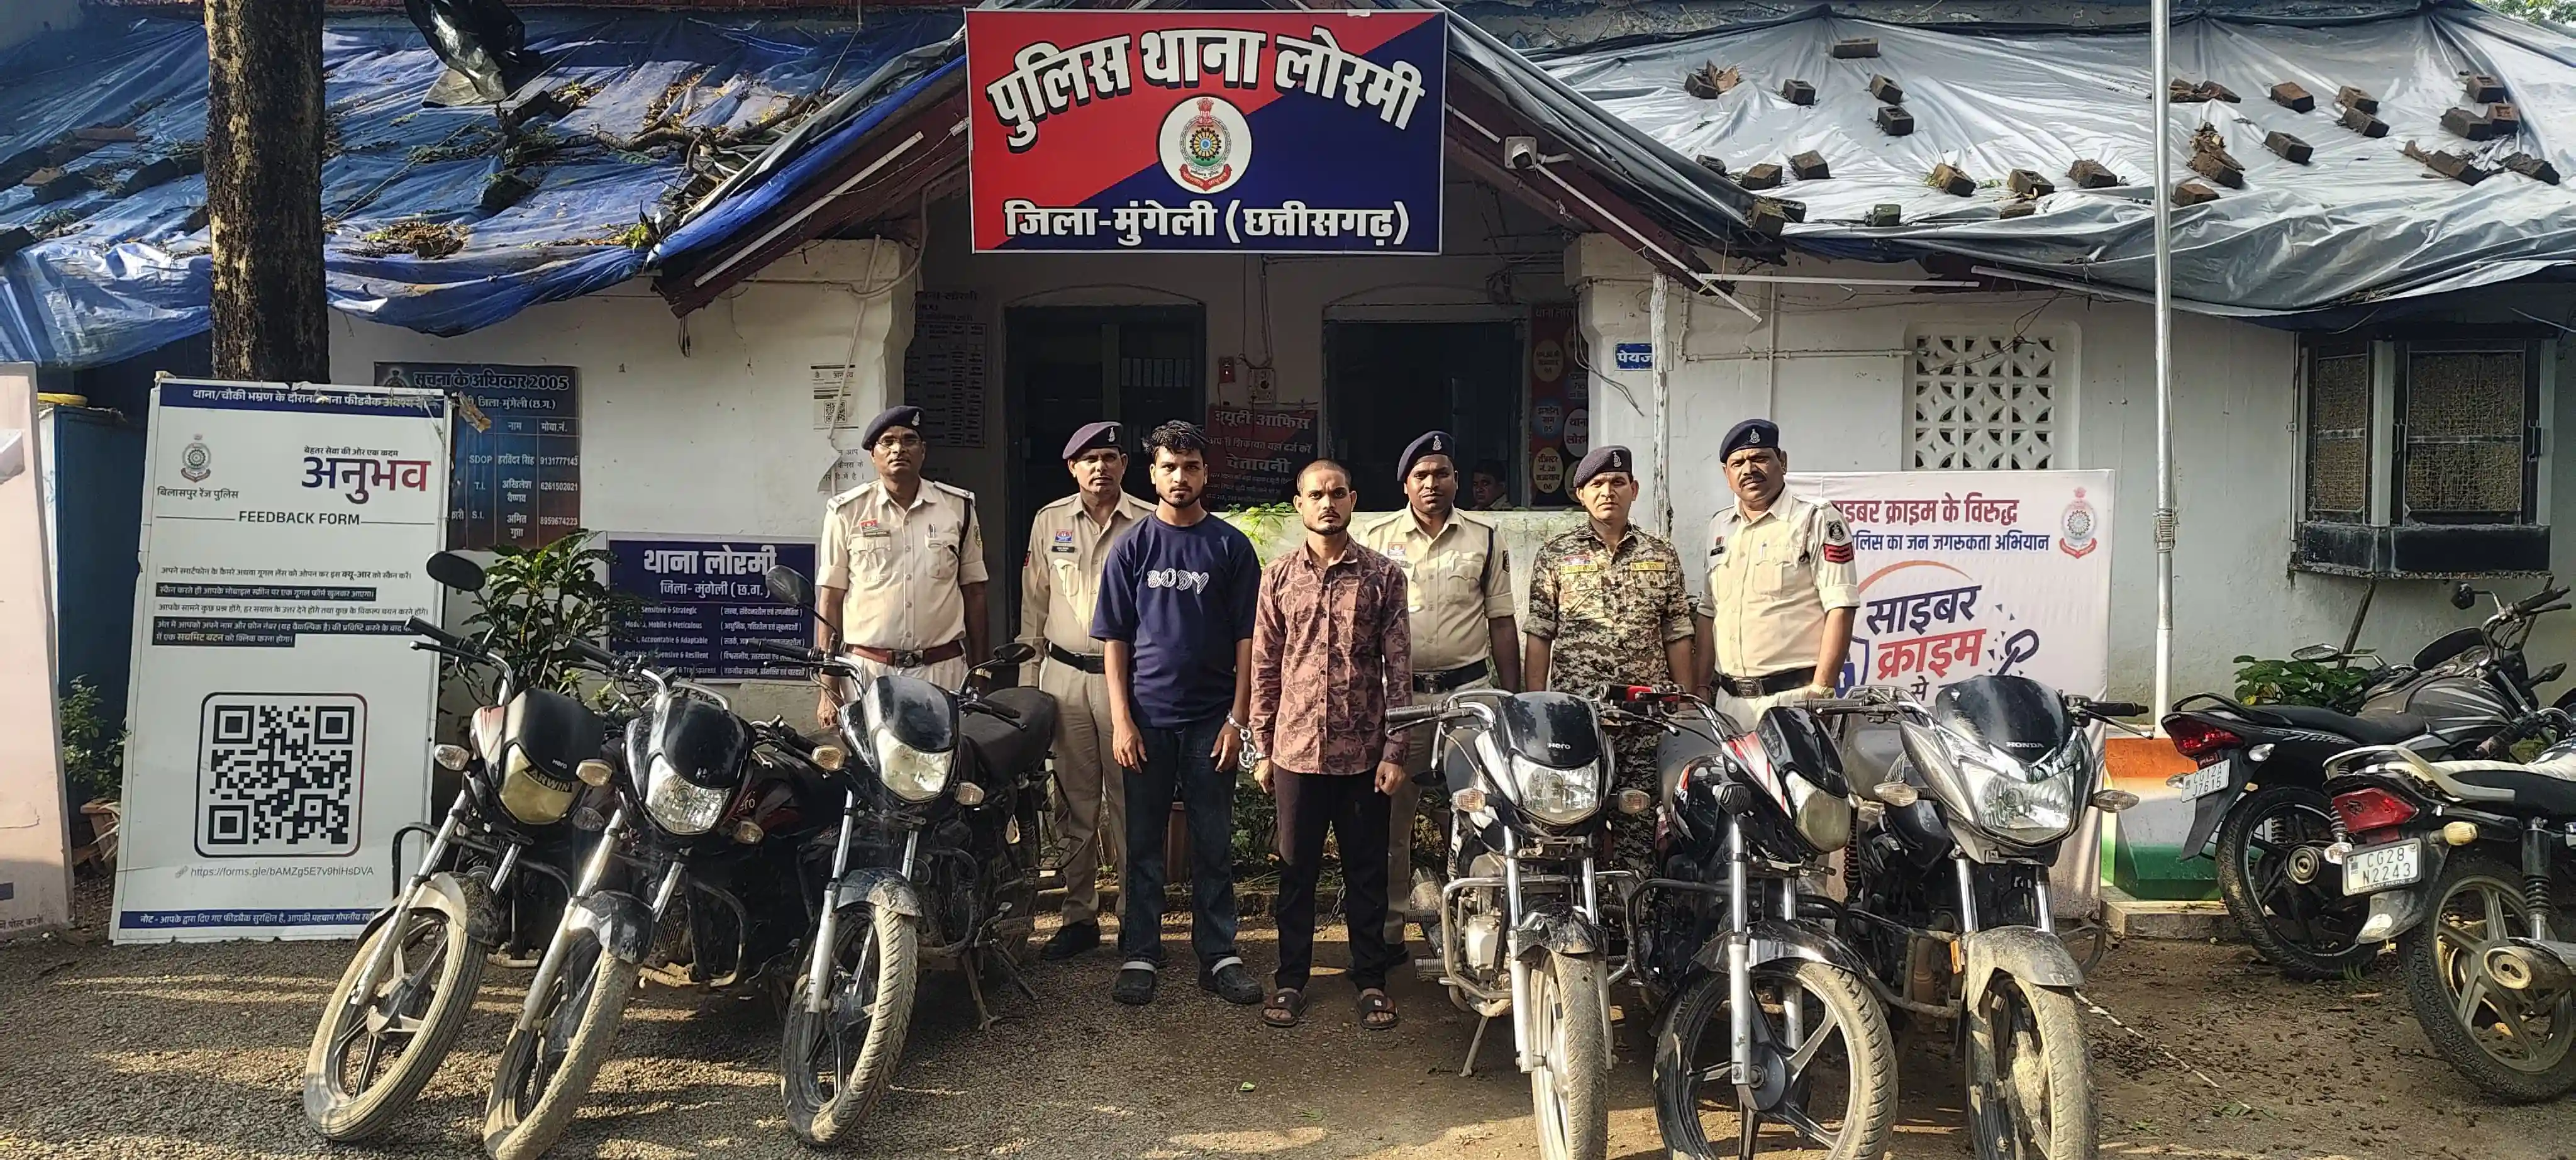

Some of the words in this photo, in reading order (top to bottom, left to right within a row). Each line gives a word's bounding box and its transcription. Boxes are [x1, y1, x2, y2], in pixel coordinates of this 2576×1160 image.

[987, 35, 1131, 148] पुलिस
[1141, 30, 1267, 86] थाना
[1275, 26, 1425, 130] लोरमी
[1005, 200, 1217, 245] जिला-मुंगेली
[1226, 199, 1409, 245] (छत्तीसगढ़)
[1617, 349, 1654, 364] पेयज
[452, 368, 470, 388] के
[472, 369, 528, 389] अधिकार
[528, 376, 569, 390] 2005
[275, 391, 286, 403] के
[287, 391, 313, 404] दौरान
[508, 421, 521, 431] नाम
[341, 447, 351, 455] की
[469, 455, 492, 464] SDOP
[301, 456, 431, 505] अनुभव
[502, 478, 532, 489] अखिलेश
[157, 486, 197, 500] बिलासपुर
[213, 488, 239, 502] पुलिस
[239, 511, 314, 525] FEEDBACK
[319, 513, 360, 526] FORM
[507, 512, 527, 524] अमित
[1885, 499, 1938, 526] क्राइम
[1942, 493, 1961, 523] के
[1887, 534, 1902, 551] का
[1906, 534, 1929, 551] जन
[1994, 530, 2051, 552] अभियान
[644, 549, 699, 574] थाना
[702, 545, 777, 575] लोरमी
[694, 581, 728, 598] मुंगेली
[1147, 568, 1209, 594] BODY
[672, 606, 697, 615] Strategic
[1866, 585, 1982, 635] साइबर
[685, 651, 709, 659] Resilient
[1877, 628, 1987, 681] क्राइम
[684, 666, 716, 674] Trasparent
[2194, 763, 2222, 784] CG12A
[2367, 847, 2405, 867] CG28
[2362, 862, 2411, 885] N2243
